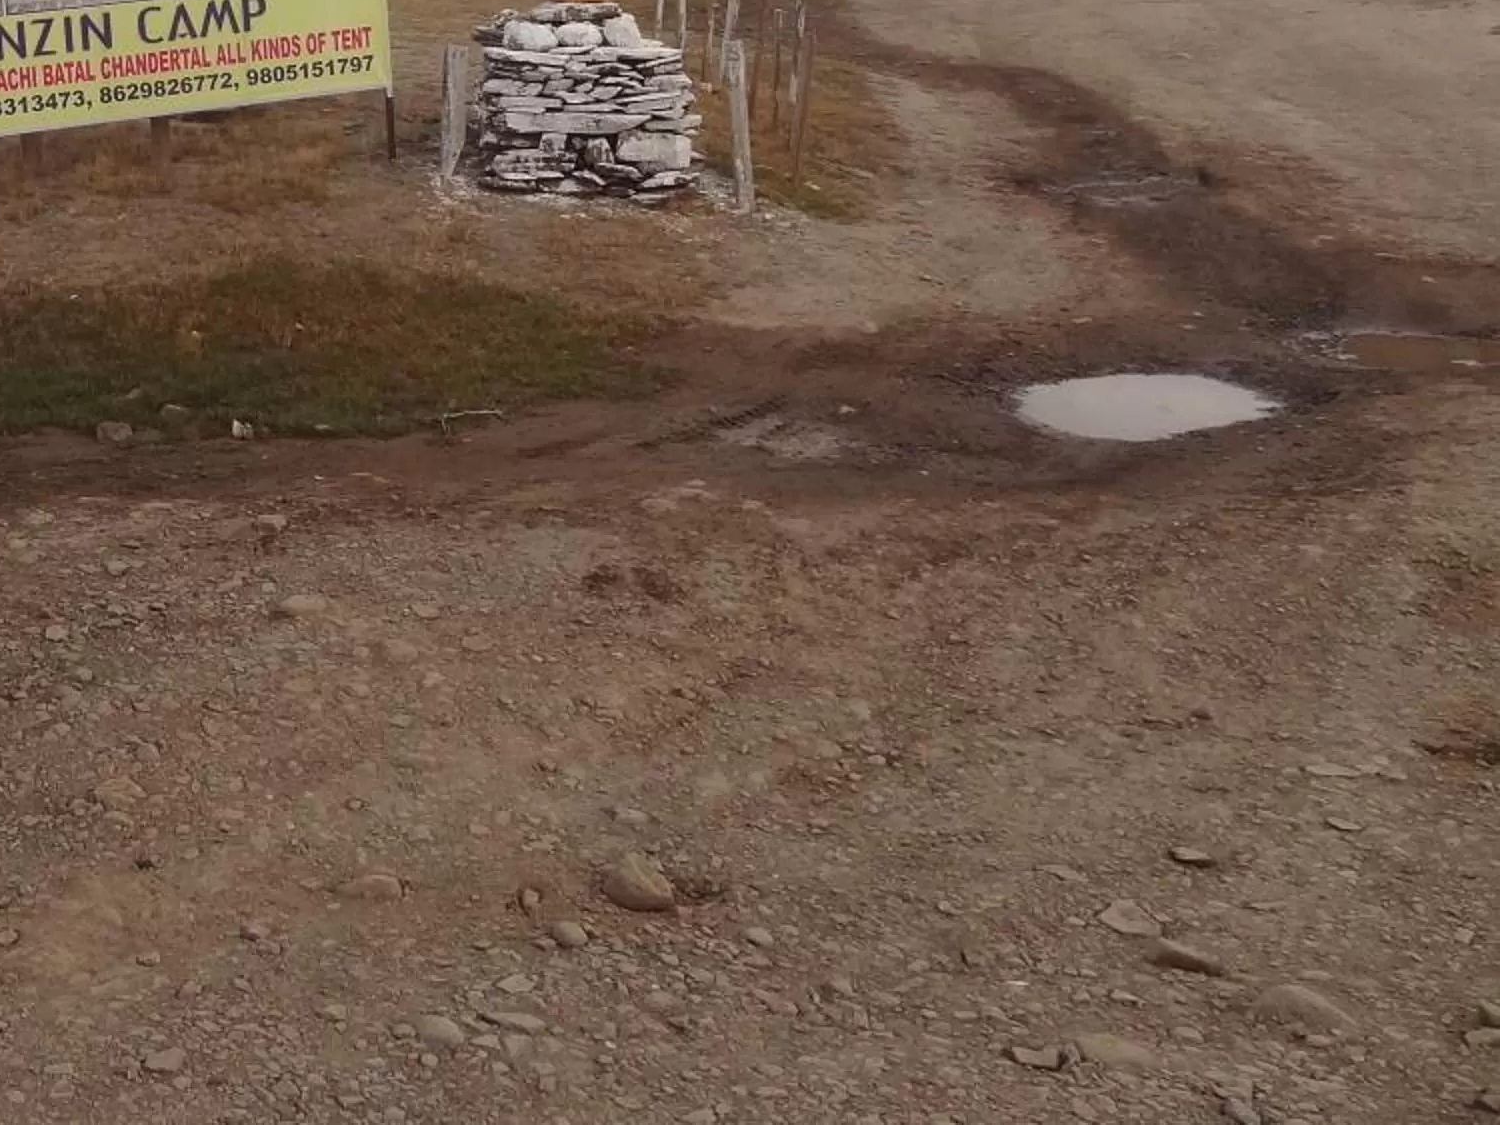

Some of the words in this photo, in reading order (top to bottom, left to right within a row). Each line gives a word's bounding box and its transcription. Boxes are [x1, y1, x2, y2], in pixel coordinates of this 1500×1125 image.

[43, 58, 96, 85] BATAL
[100, 45, 211, 79] CHANDERTAL
[216, 43, 246, 66] ALL
[251, 35, 301, 62] KINDS
[307, 32, 327, 55] OF
[332, 27, 372, 51] TENT
[100, 72, 239, 104] 8629826772,
[247, 55, 374, 85] 9805151797
